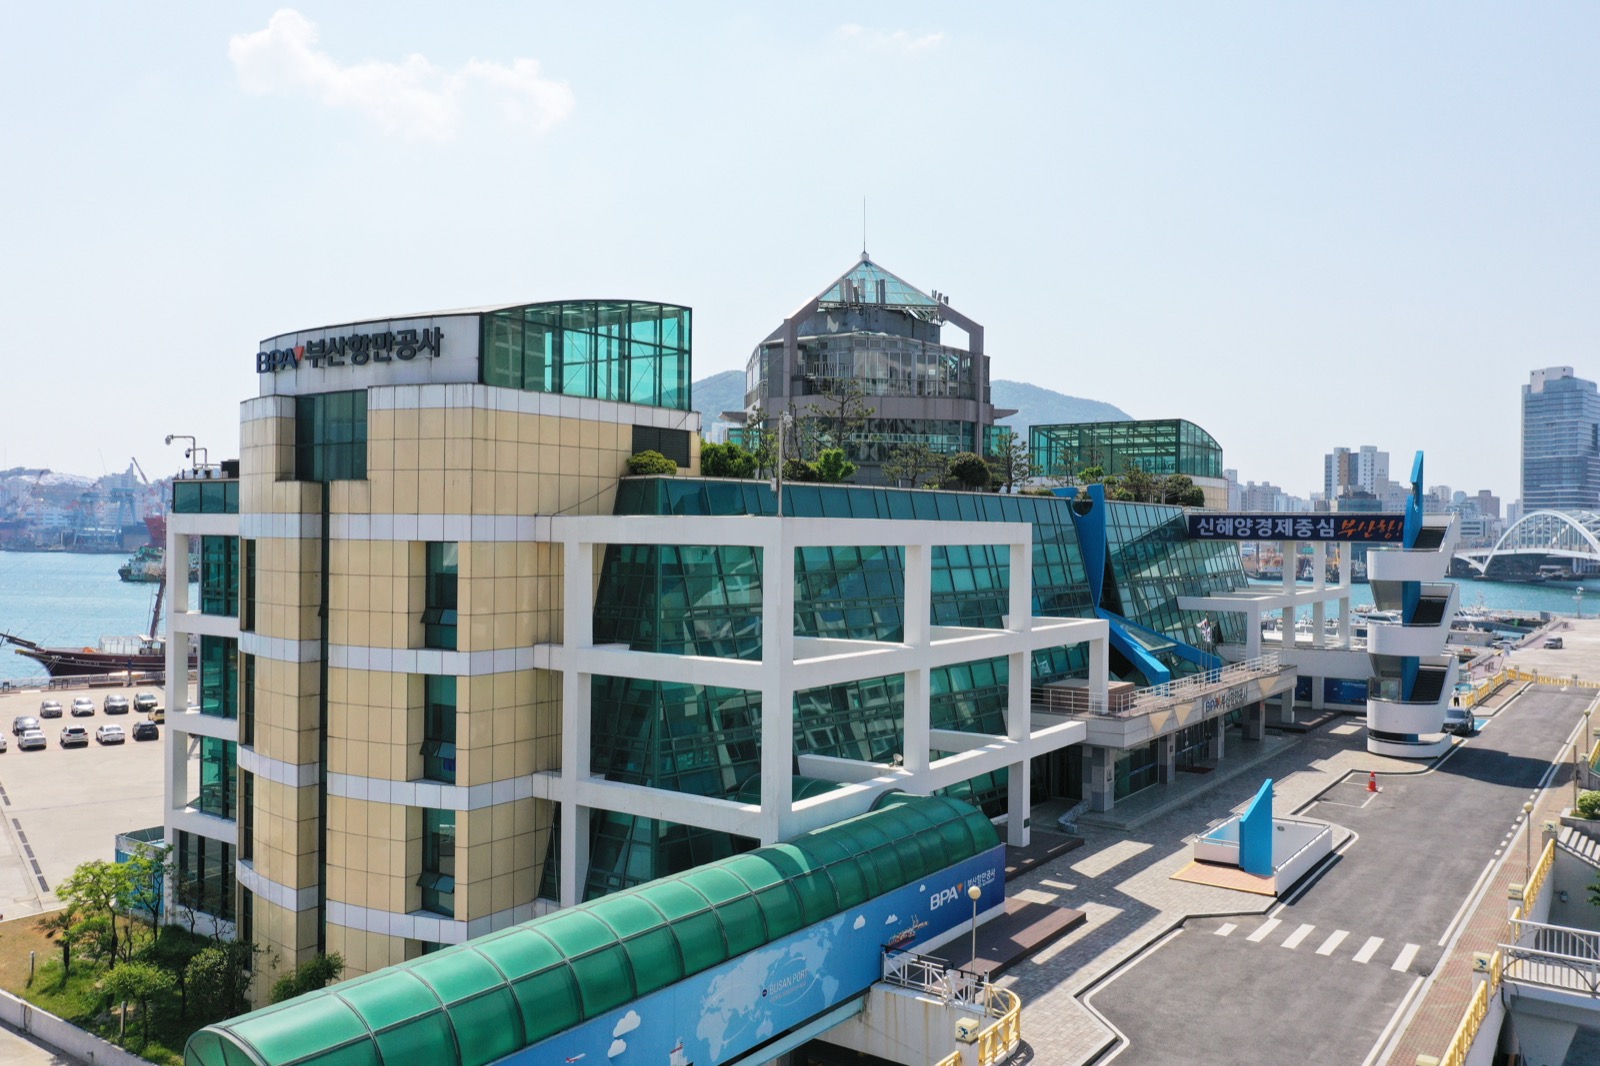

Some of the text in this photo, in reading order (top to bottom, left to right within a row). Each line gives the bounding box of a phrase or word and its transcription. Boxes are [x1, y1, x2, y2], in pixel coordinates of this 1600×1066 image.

[256, 327, 444, 373] BPA 부산항만공사
[1197, 518, 1403, 539] 신해양경제중심 부산항!
[930, 886, 959, 911] BPA
[769, 976, 792, 995] BUSAN
[792, 968, 809, 984] PORT
